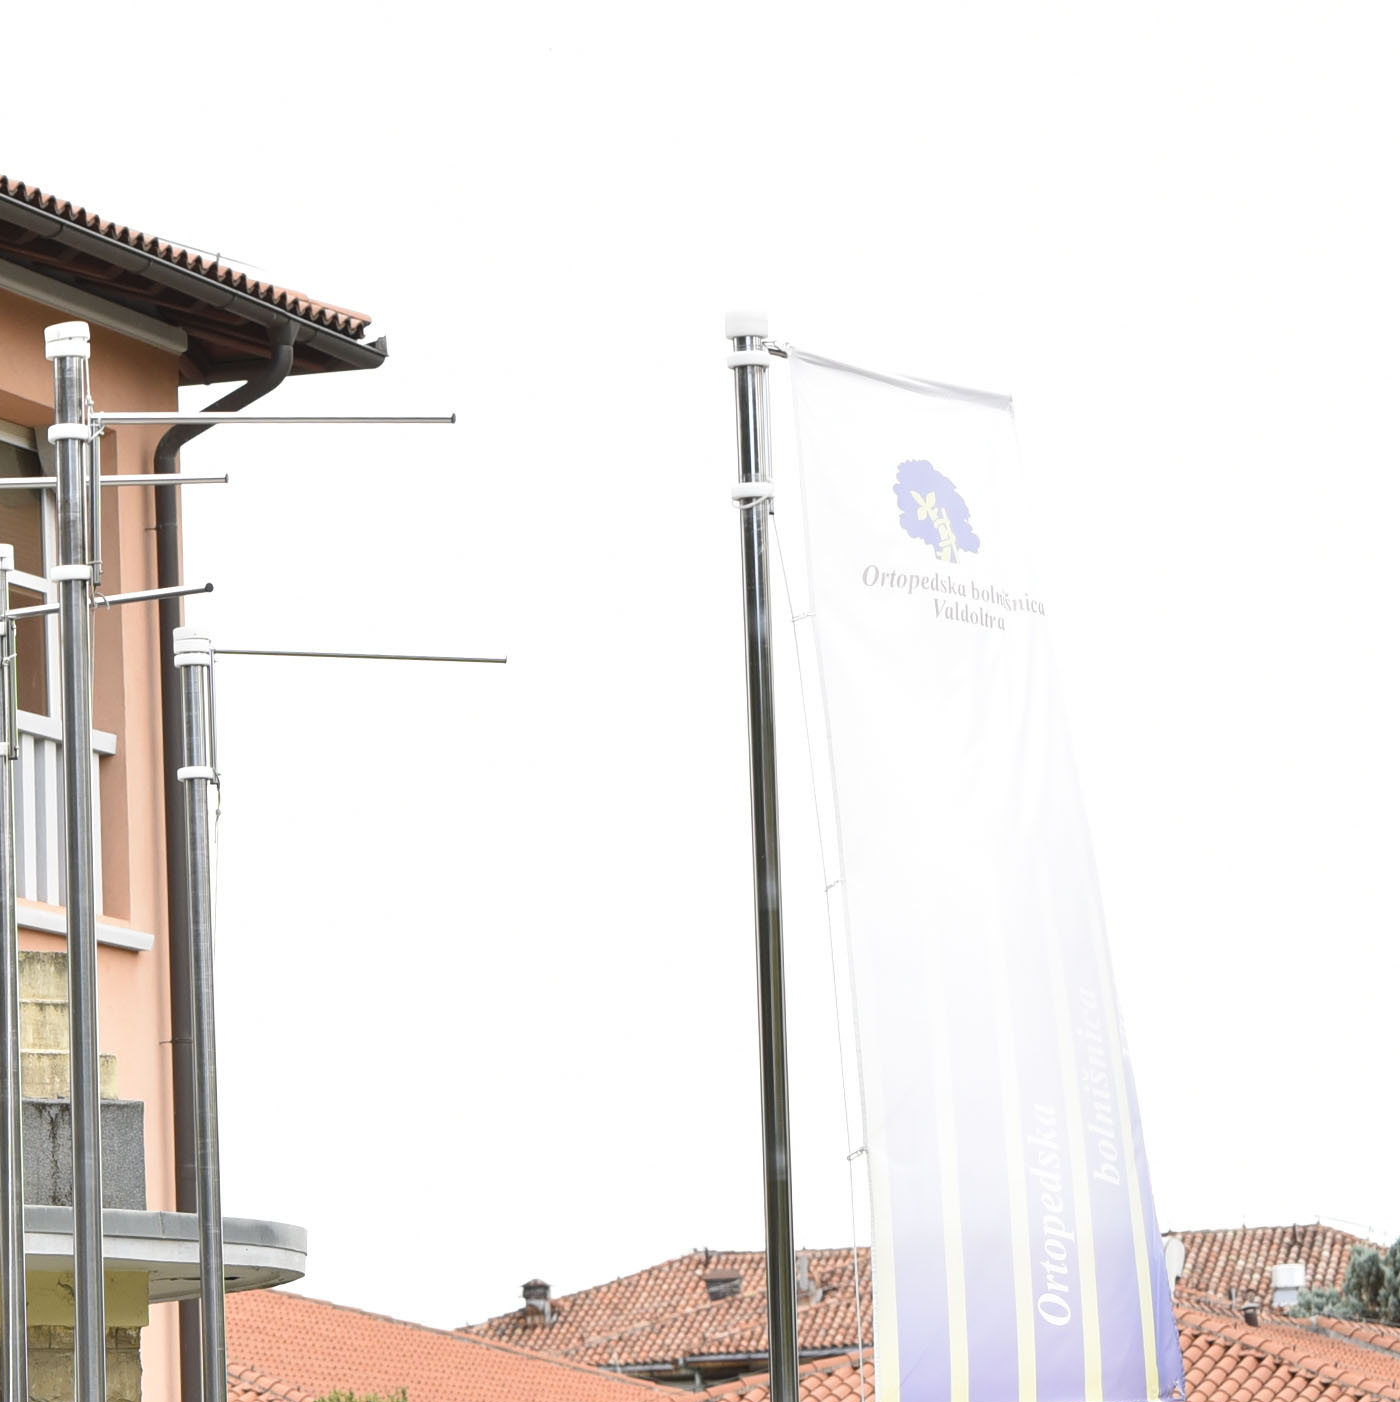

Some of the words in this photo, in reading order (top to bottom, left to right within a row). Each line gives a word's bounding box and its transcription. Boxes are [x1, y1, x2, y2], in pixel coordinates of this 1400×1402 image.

[862, 565, 966, 597] Ortopedska
[933, 598, 1006, 631] Valdoltra
[1075, 987, 1120, 1186] bolnišnica
[1027, 1104, 1075, 1327] Ortopedska
